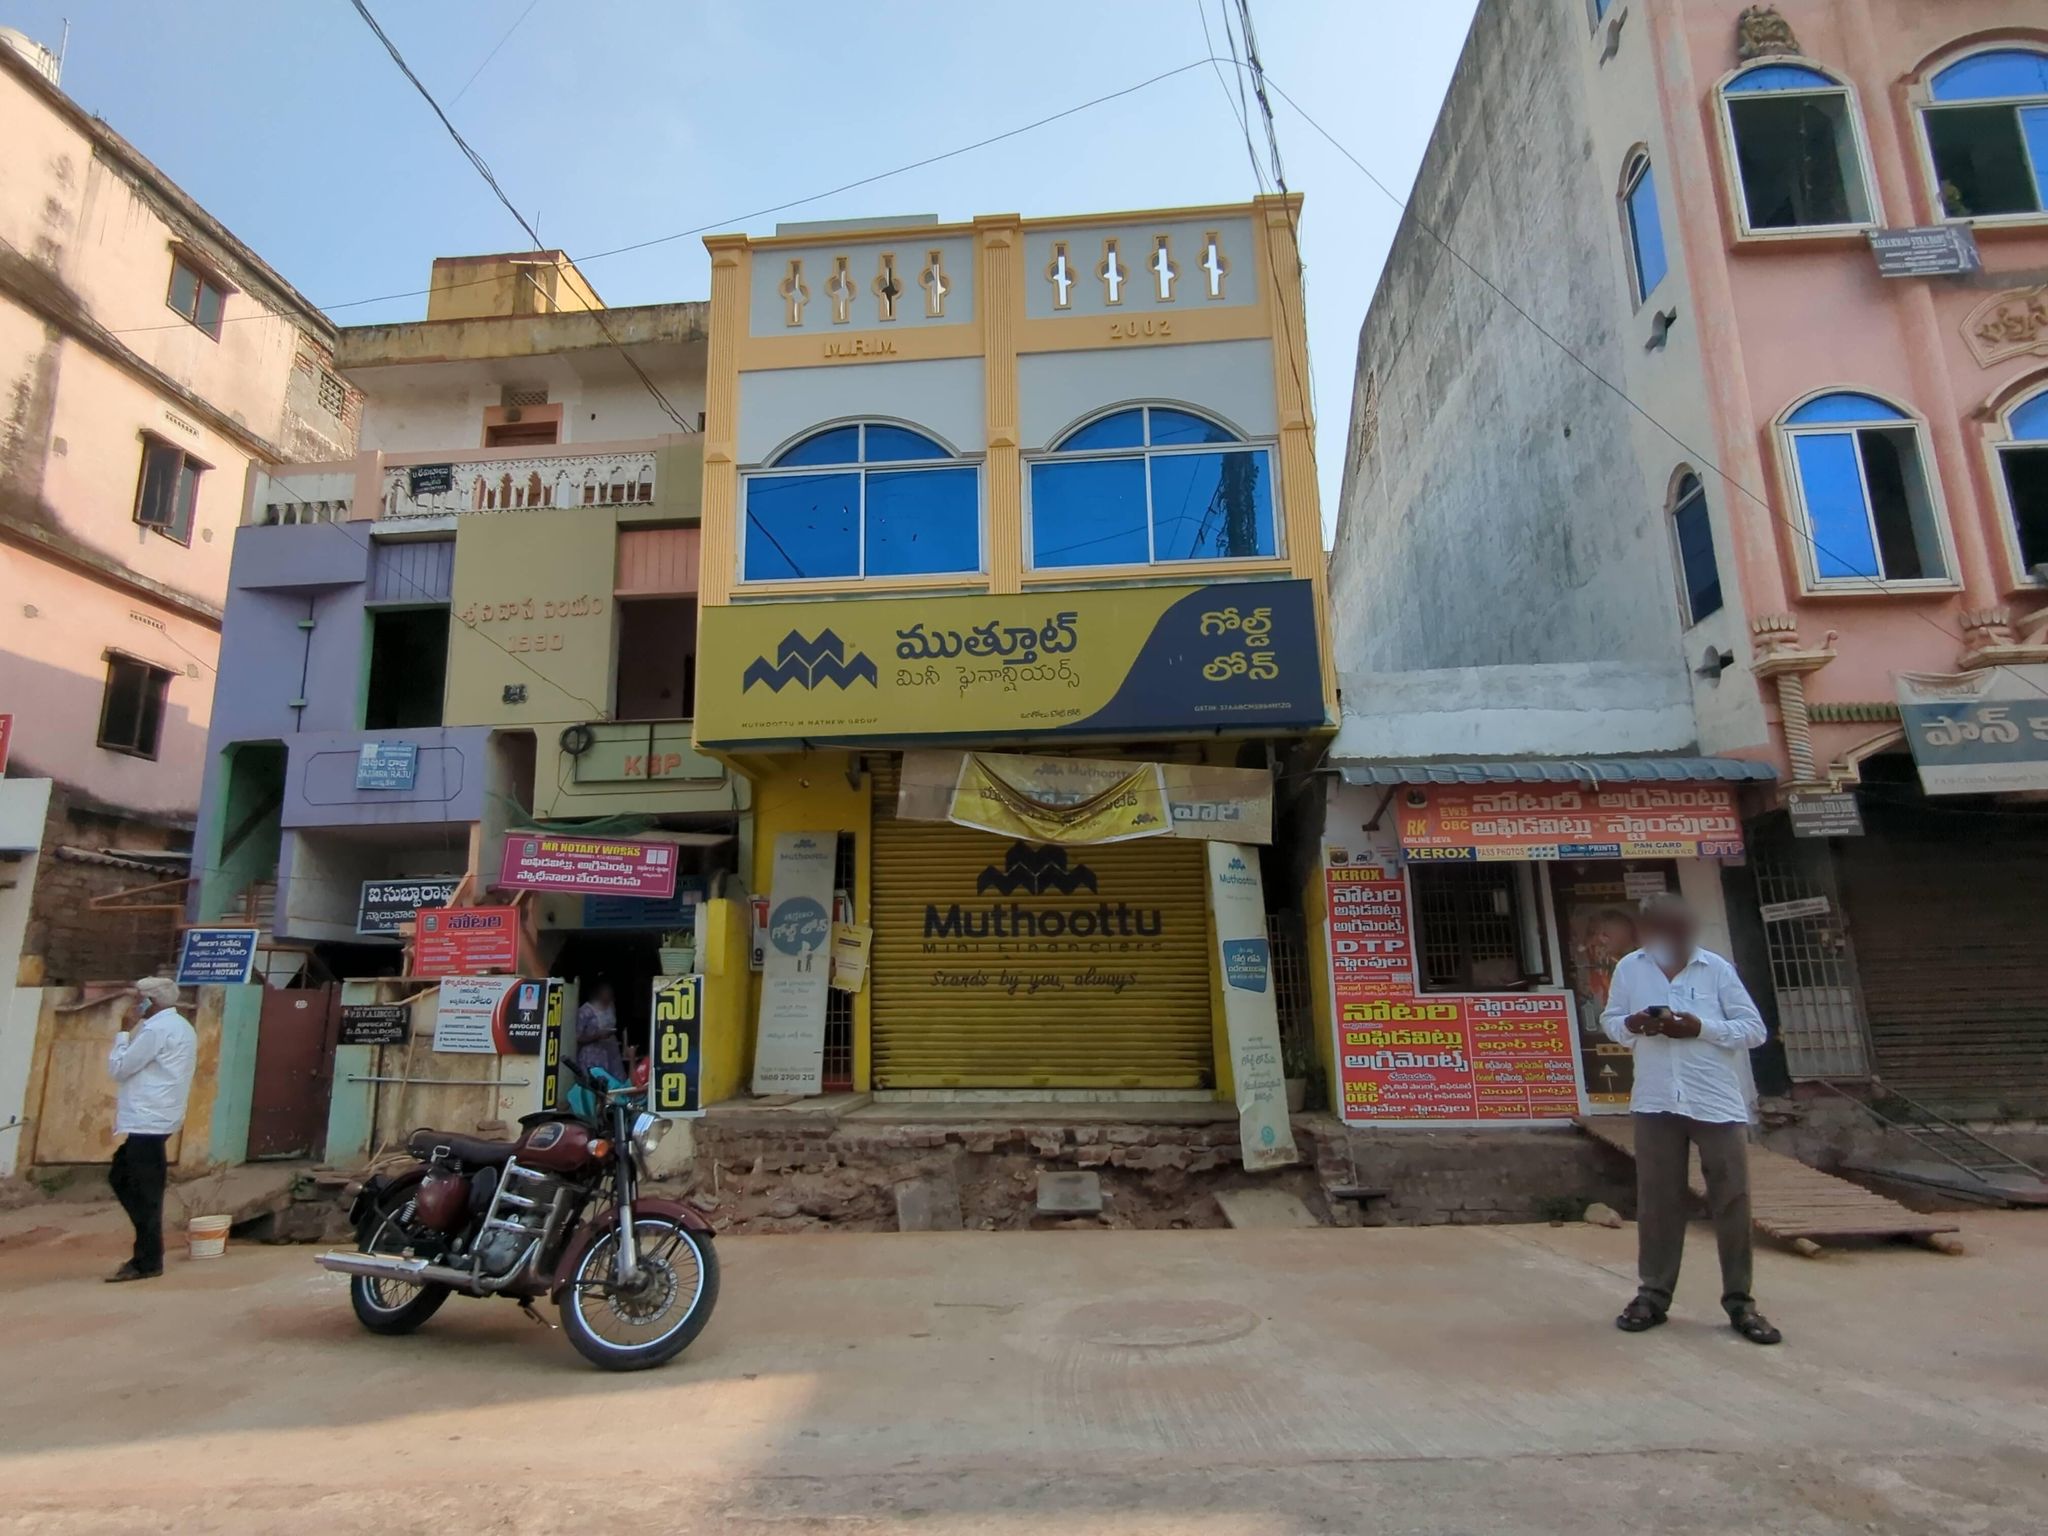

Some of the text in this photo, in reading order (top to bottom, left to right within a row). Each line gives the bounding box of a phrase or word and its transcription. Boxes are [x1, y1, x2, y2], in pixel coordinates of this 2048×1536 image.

[1110, 319, 1171, 338] 2002
[1200, 607, 1272, 646] గోల్డ్
[508, 634, 563, 653] 1990
[1202, 651, 1279, 681] లోన్
[896, 665, 940, 686] మినీ
[808, 718, 845, 727] MATHEW
[1440, 806, 1468, 816] EWS
[1407, 819, 1428, 836] RK
[1441, 820, 1470, 831] OBC
[1403, 836, 1431, 844] ONLINE
[542, 841, 559, 852] MR
[561, 842, 600, 854] NOTARY
[602, 845, 641, 857] WORKS
[1407, 847, 1471, 859] XEROX
[1478, 845, 1525, 857] PASS PHOTOS
[1702, 842, 1744, 855] DTP
[1332, 869, 1380, 881] XEROX
[923, 903, 1162, 938] Muthoottu
[923, 943, 1163, 954] Mini Financiers
[1336, 940, 1405, 953] DTP
[215, 968, 244, 976] NOTARY
[931, 969, 988, 988] Stands
[999, 968, 1018, 995] by
[1074, 968, 1138, 994] always
[1345, 1082, 1377, 1092] EWS
[1346, 1093, 1378, 1103] OBC
